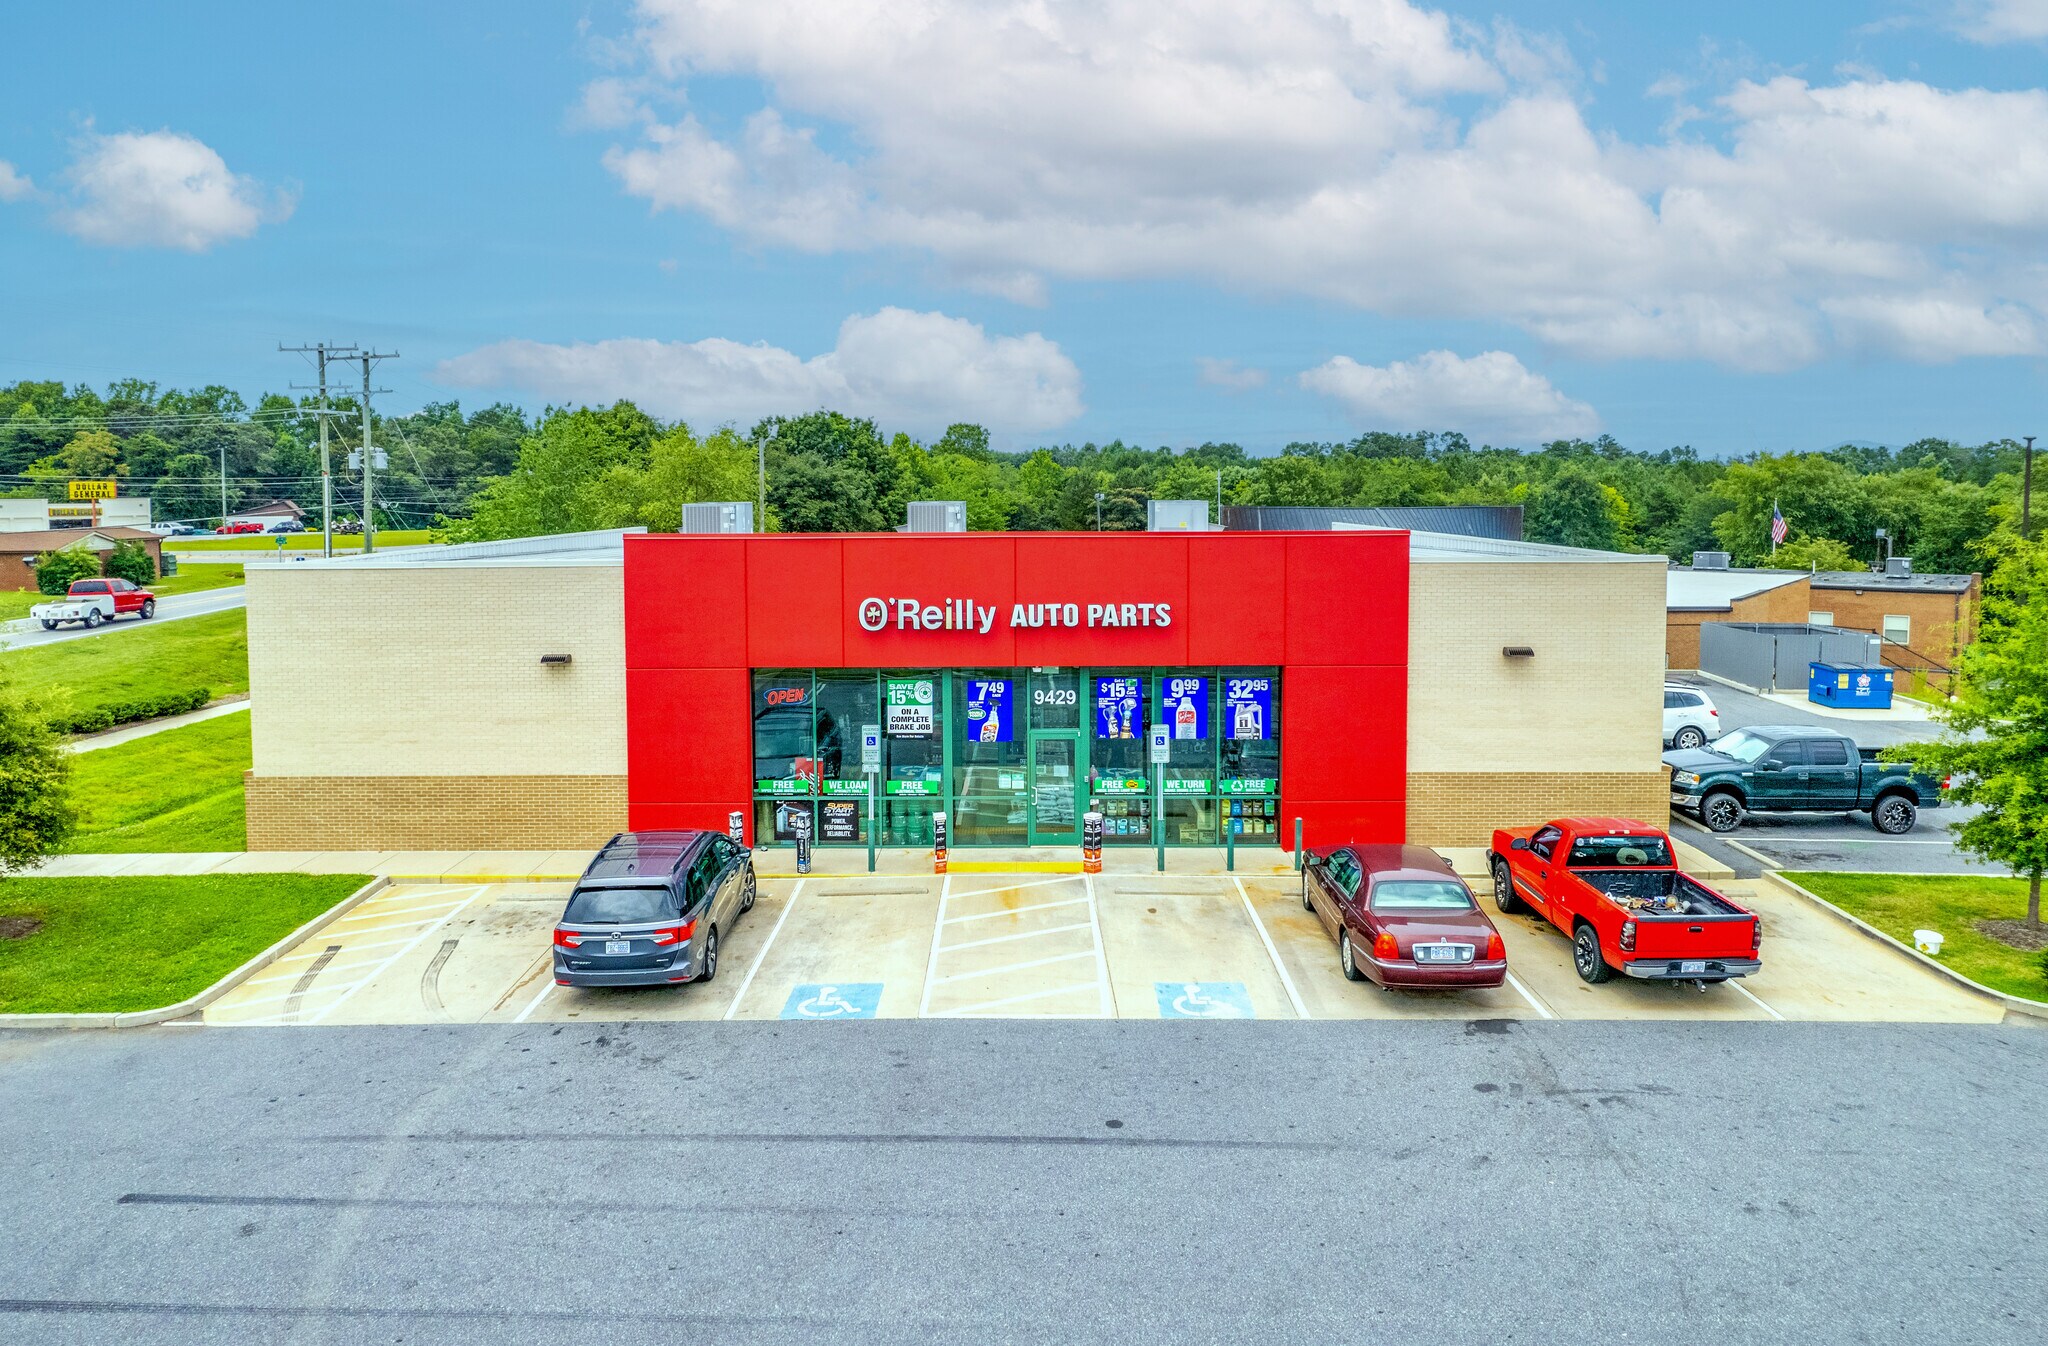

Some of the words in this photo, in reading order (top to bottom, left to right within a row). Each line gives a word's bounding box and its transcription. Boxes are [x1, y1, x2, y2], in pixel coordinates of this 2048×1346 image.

[74, 490, 111, 498] GENERAL
[858, 597, 997, 634] O'Reilly
[1009, 603, 1079, 628] AUTO
[1087, 603, 1172, 628] PARTS
[1101, 682, 1126, 698] $15
[767, 688, 805, 706] OPEN
[889, 690, 915, 705] 15%
[1034, 689, 1077, 705] 9429
[889, 723, 914, 731] BRAKE
[916, 723, 931, 731] JOB
[772, 780, 795, 789] FREE
[828, 780, 842, 789] WE
[845, 780, 868, 789] LOAN
[901, 781, 923, 790] FREE
[1101, 780, 1124, 789] FREE
[1166, 780, 1180, 789] WE
[1182, 780, 1205, 789] TURN
[1244, 780, 1266, 789] FREE
